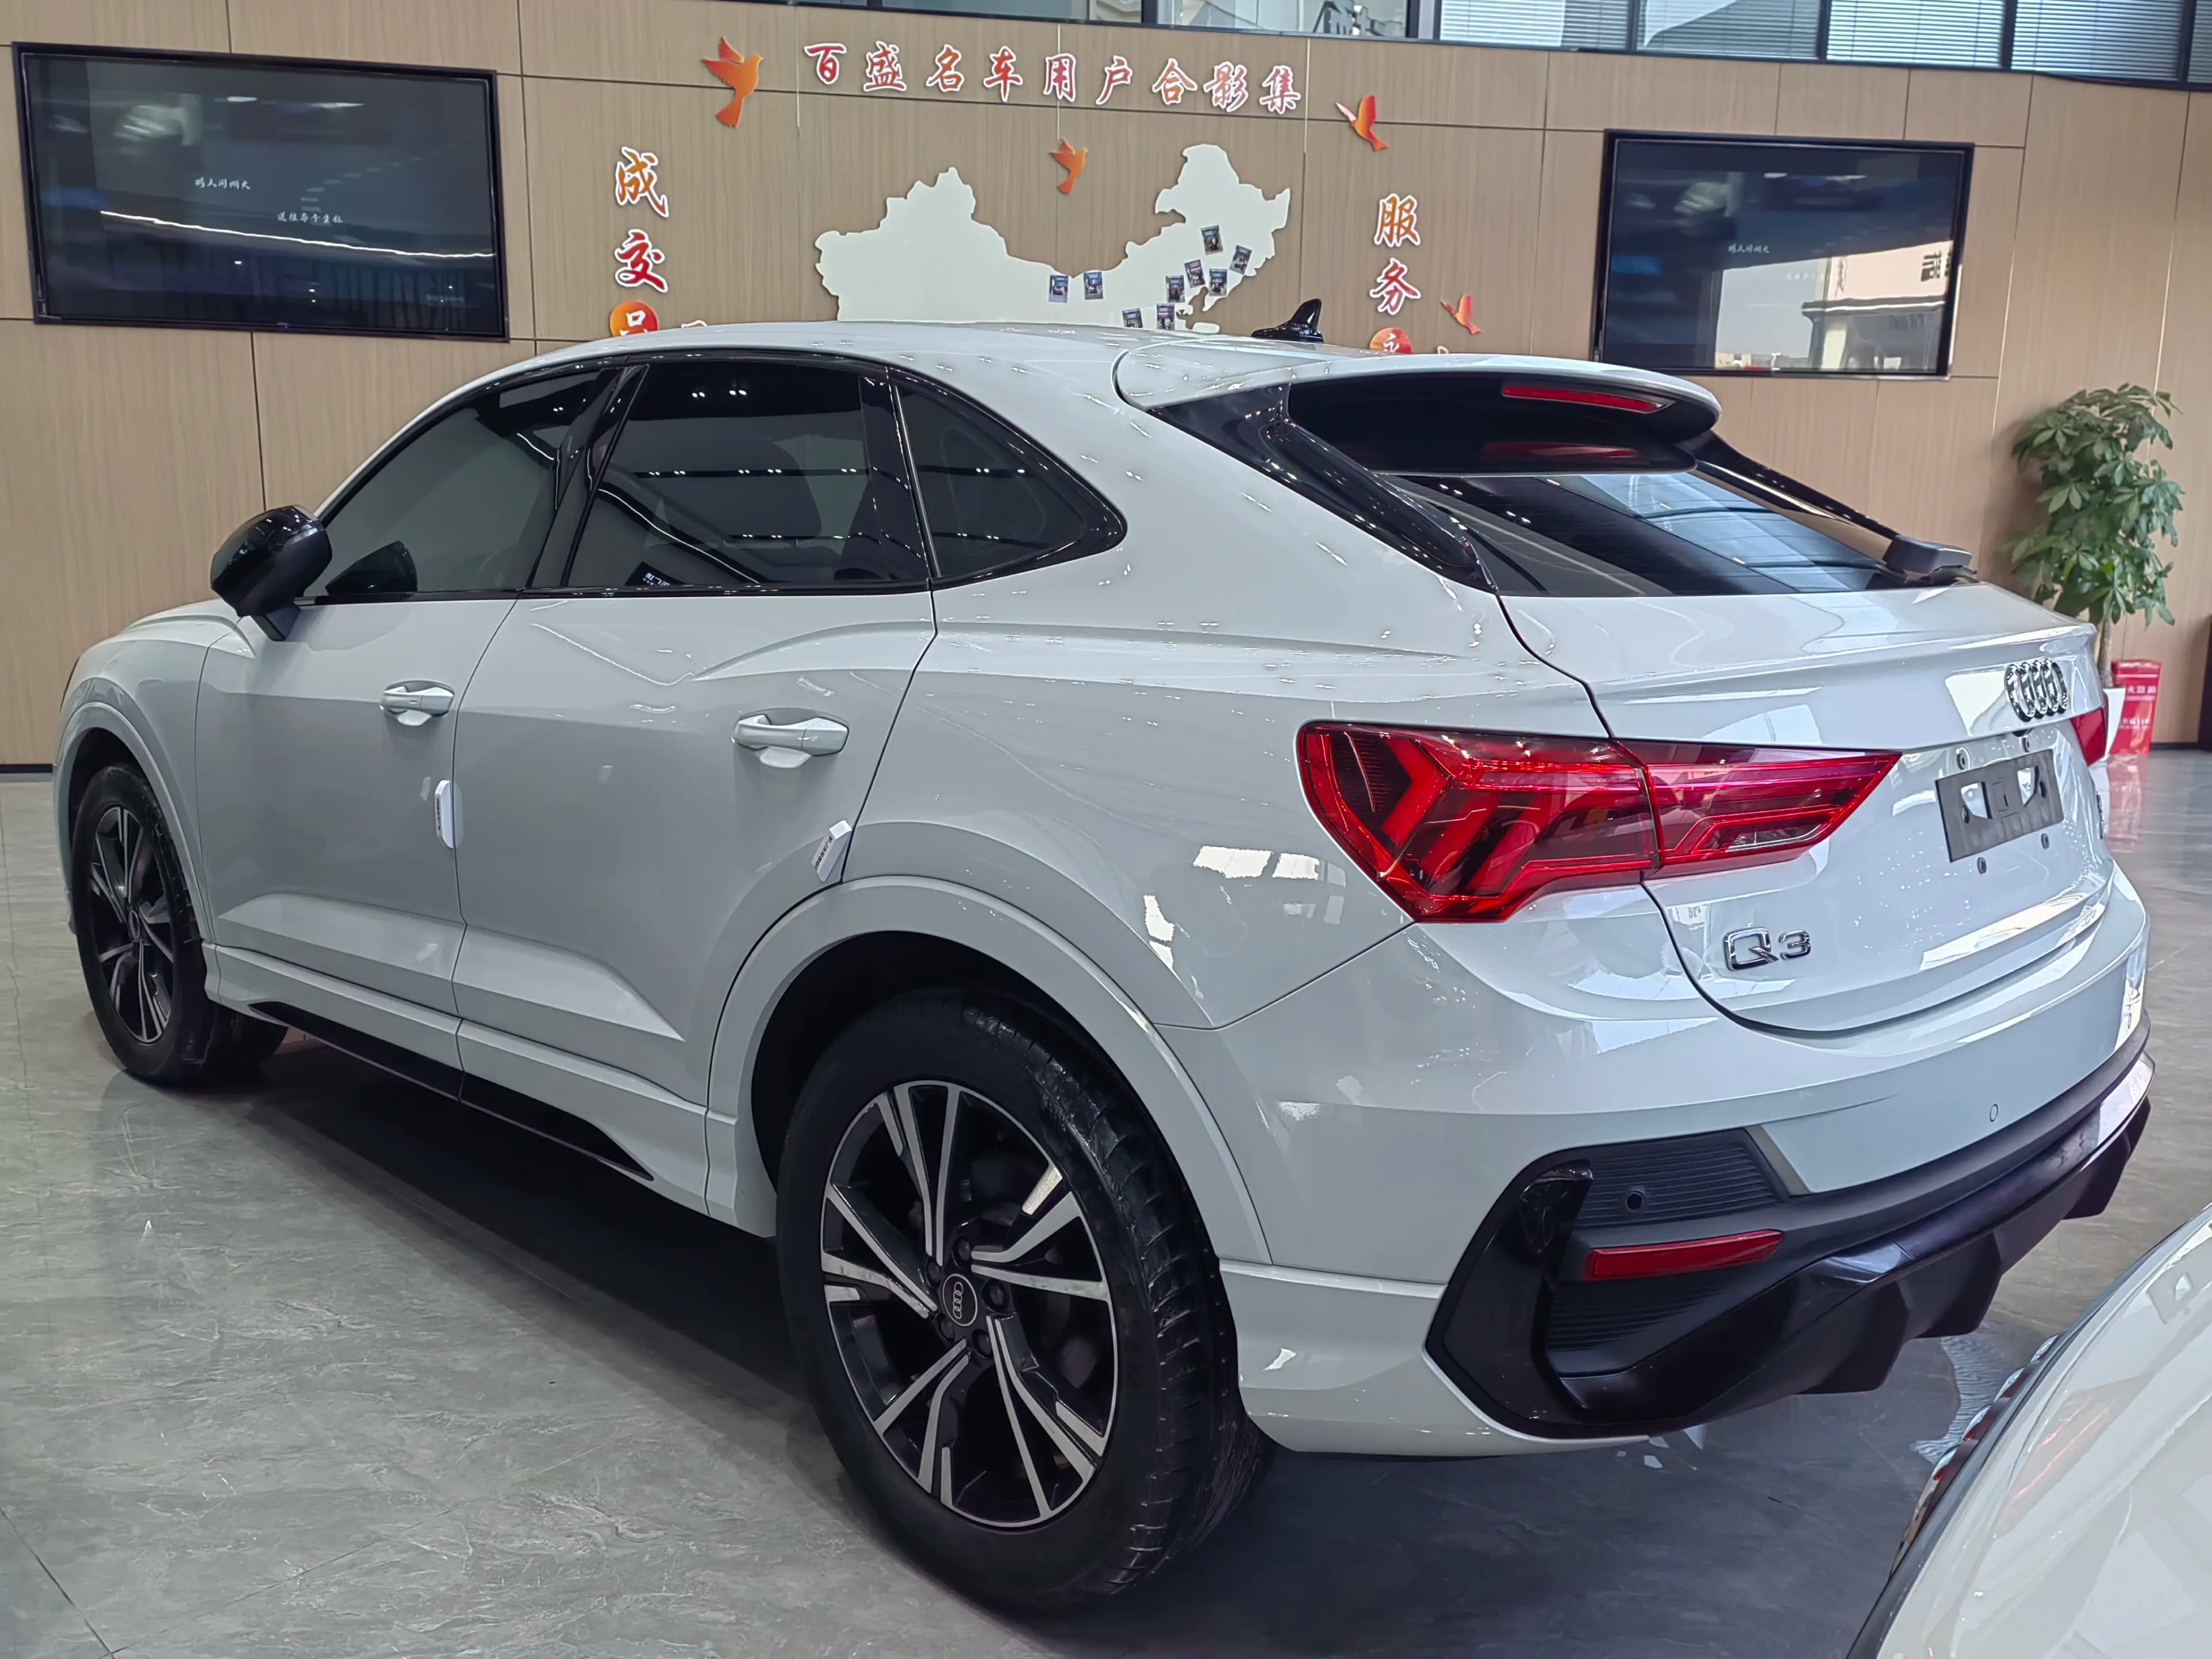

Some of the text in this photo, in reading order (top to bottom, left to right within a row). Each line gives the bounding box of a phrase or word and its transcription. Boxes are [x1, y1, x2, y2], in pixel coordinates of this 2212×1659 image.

[805, 40, 1302, 115] 百盛名车用户合影集
[614, 146, 669, 293] 成交
[1369, 193, 1421, 315] 服务
[1724, 927, 1811, 971] Q3
